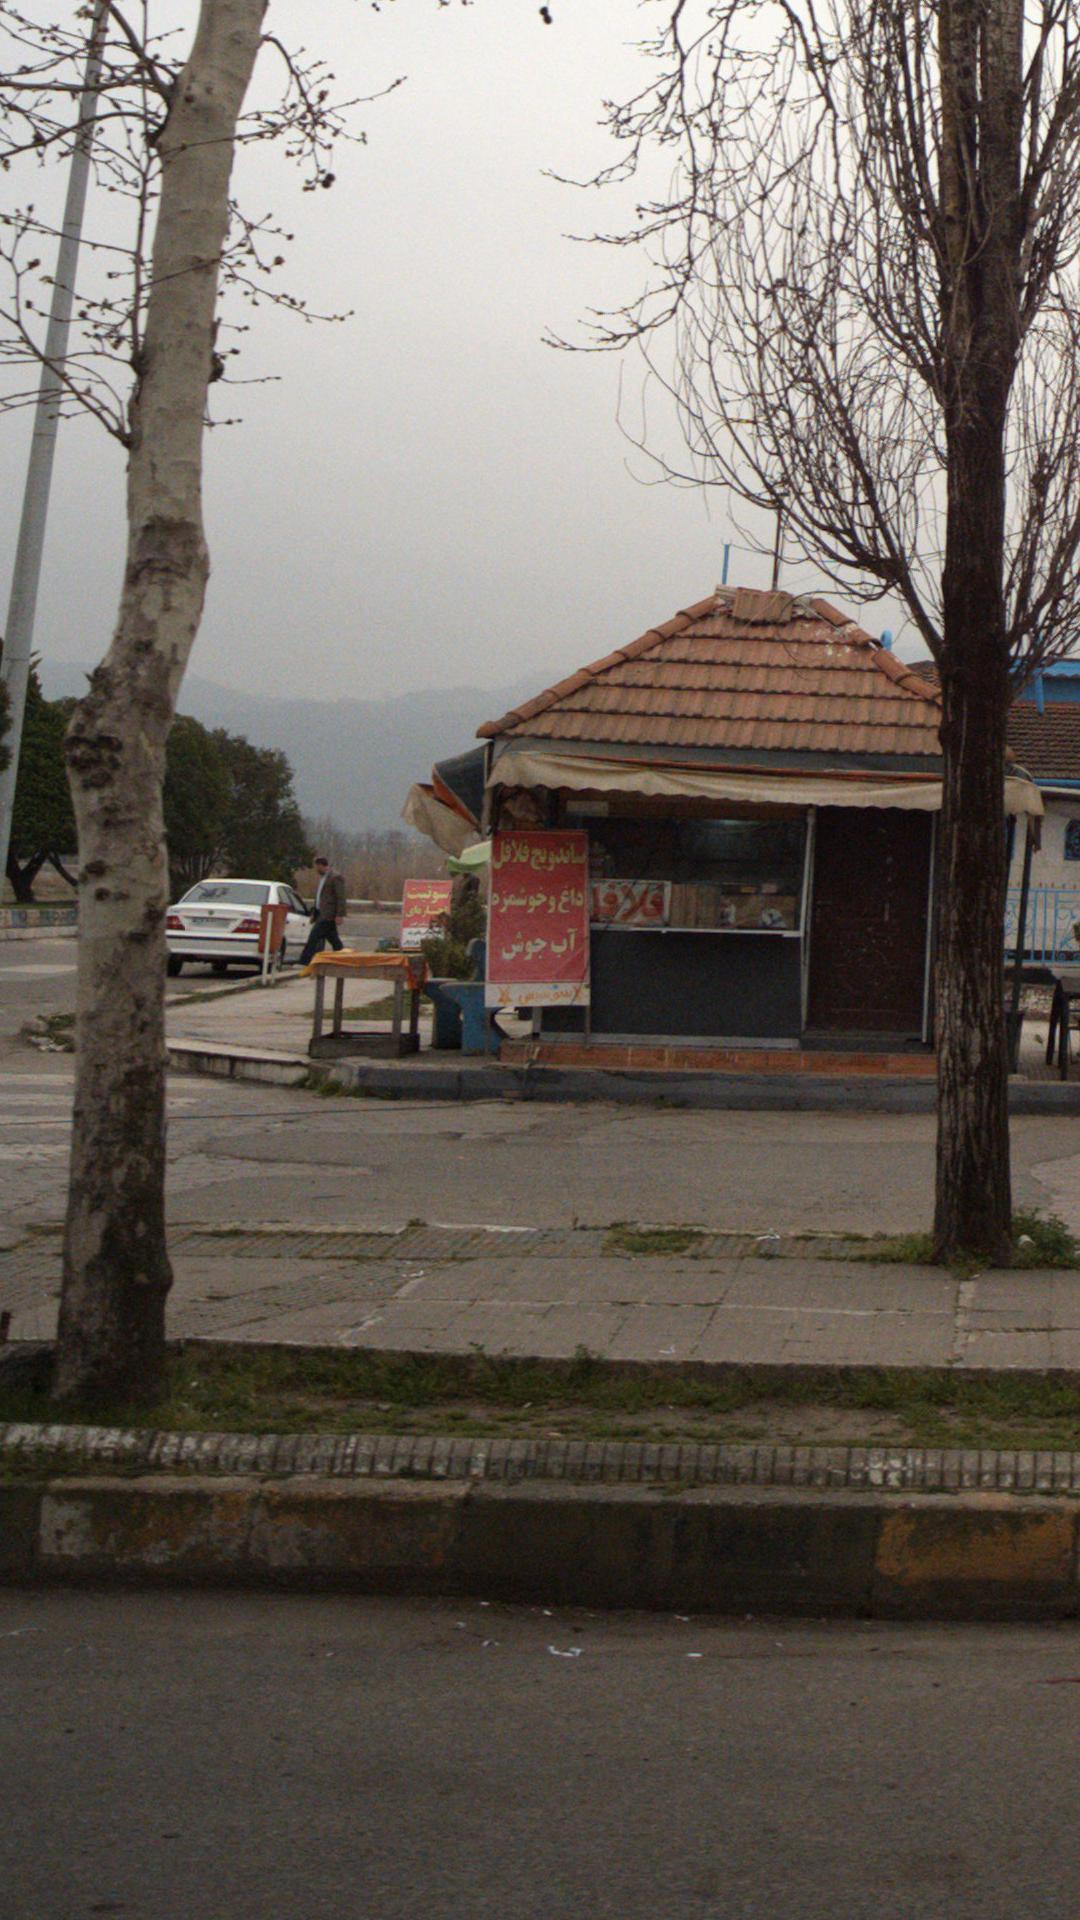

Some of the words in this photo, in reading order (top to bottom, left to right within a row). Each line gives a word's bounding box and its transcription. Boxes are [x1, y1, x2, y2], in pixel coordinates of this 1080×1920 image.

[492, 838, 529, 870] فلافل
[492, 885, 547, 913] خوشمزه
[547, 896, 556, 913] و
[557, 886, 584, 913] داغ
[502, 931, 547, 960] جوش
[550, 928, 578, 959] آب
